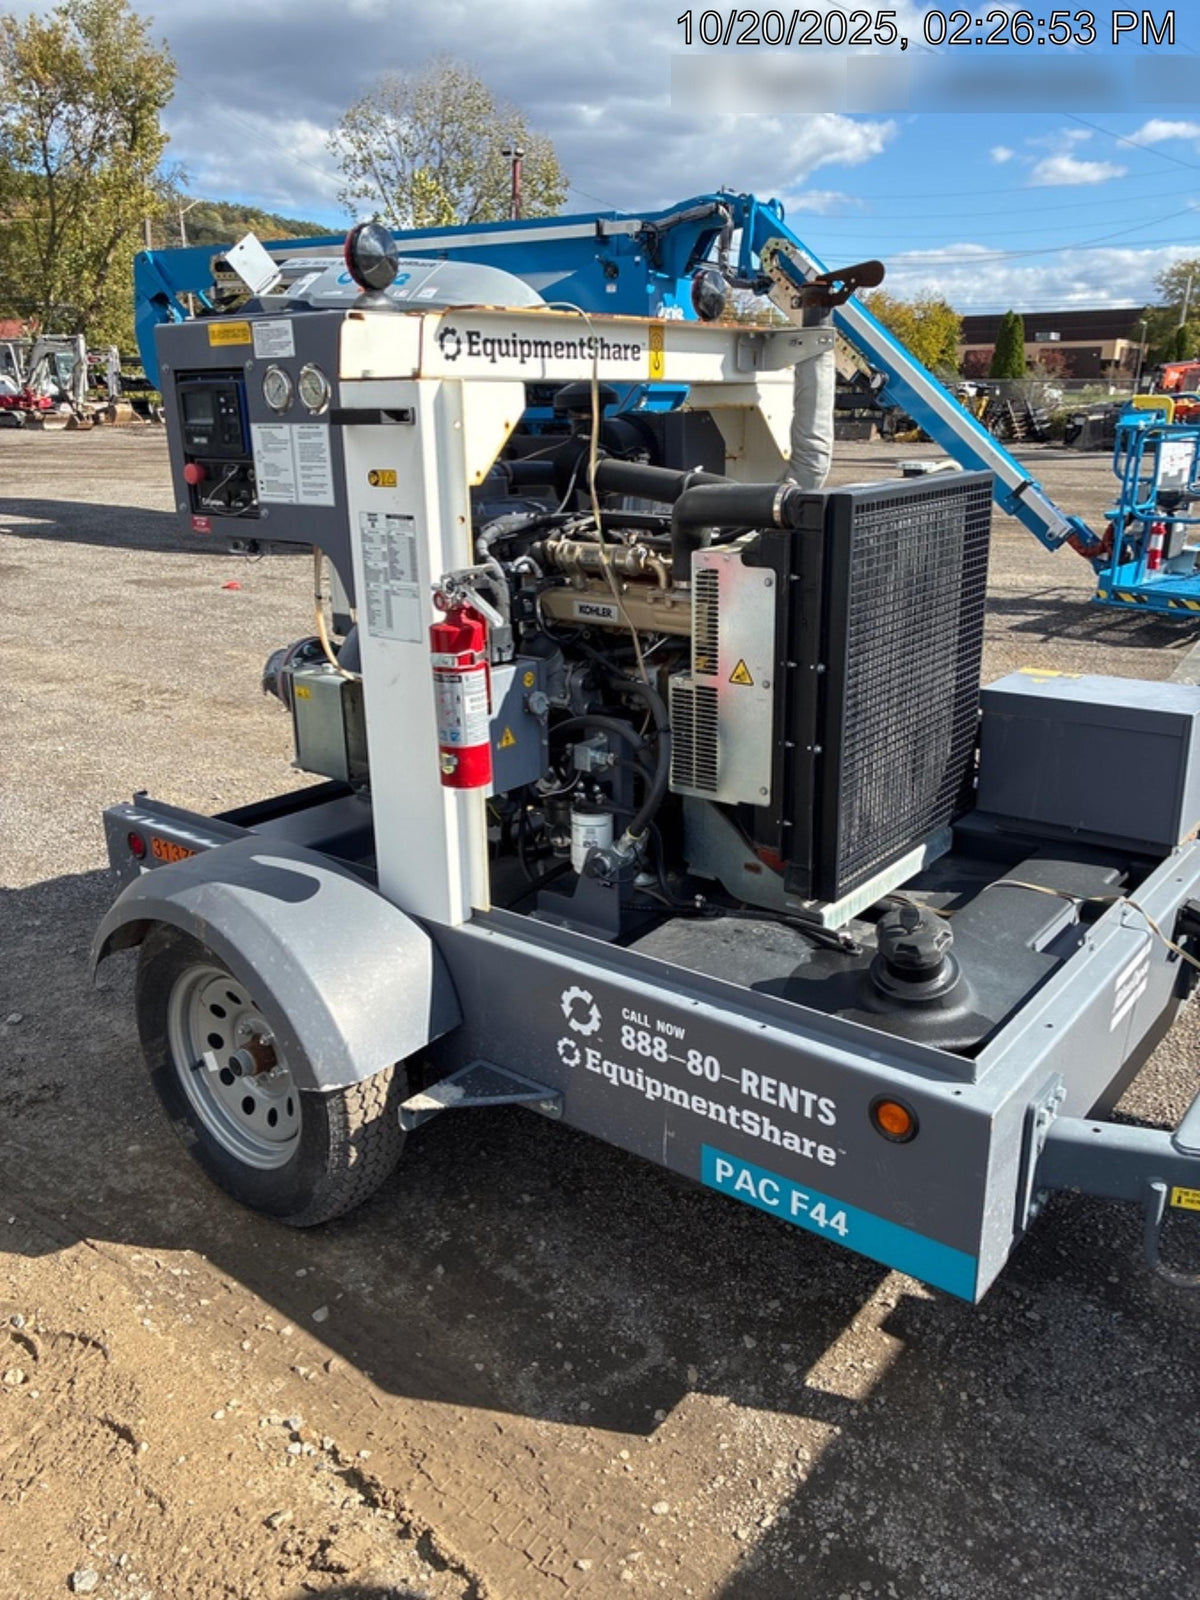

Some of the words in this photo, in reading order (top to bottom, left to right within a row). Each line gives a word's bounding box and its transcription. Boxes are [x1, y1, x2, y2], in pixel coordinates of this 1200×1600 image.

[465, 330, 641, 364] EquipmentShare
[578, 604, 614, 619] KOHLER
[621, 1007, 651, 1029] CALL
[656, 1019, 686, 1040] NOW
[584, 1046, 838, 1167] EquipmentShare
[715, 1158, 780, 1207] PAC
[790, 1189, 849, 1237] F44
